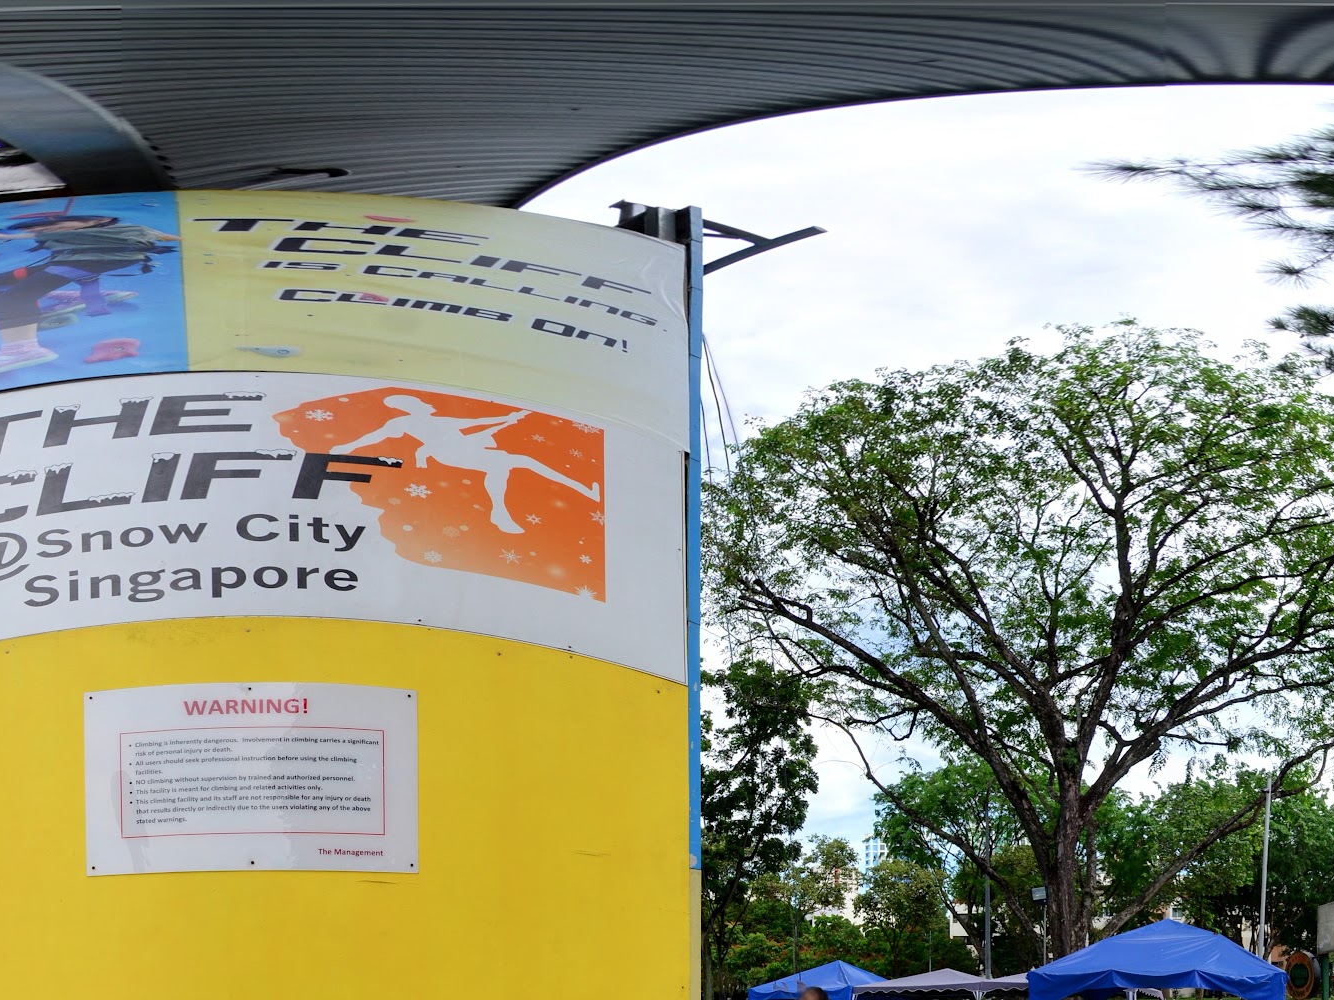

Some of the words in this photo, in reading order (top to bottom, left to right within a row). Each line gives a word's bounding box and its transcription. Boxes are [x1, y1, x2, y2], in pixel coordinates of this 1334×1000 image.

[193, 217, 490, 246] THE
[262, 260, 341, 271] IS
[272, 236, 652, 295] CLIFF
[235, 513, 366, 552] City
[23, 562, 359, 608] Singapore
[183, 698, 308, 716] WARNING!
[135, 740, 163, 748] Climbing
[169, 738, 203, 747] inherently
[203, 737, 239, 745] dangerous.
[347, 738, 380, 746] significant
[155, 748, 183, 757] personal
[183, 747, 202, 756] injury
[201, 755, 240, 764] professional
[300, 755, 317, 763] using
[330, 756, 357, 764] climbing
[147, 777, 173, 785] climbing
[201, 775, 237, 783] supervision
[322, 775, 356, 783] personnel.
[149, 787, 171, 796] facility
[307, 784, 323, 792] only.
[150, 797, 176, 805] climbing
[177, 796, 199, 804] facility
[263, 794, 300, 802] responsible
[311, 795, 324, 803] any
[324, 795, 343, 803] injury
[172, 805, 197, 813] directly
[205, 804, 236, 812] indirectly
[136, 817, 156, 825] stated
[157, 816, 188, 824] warnings.
[334, 848, 384, 857] Management
